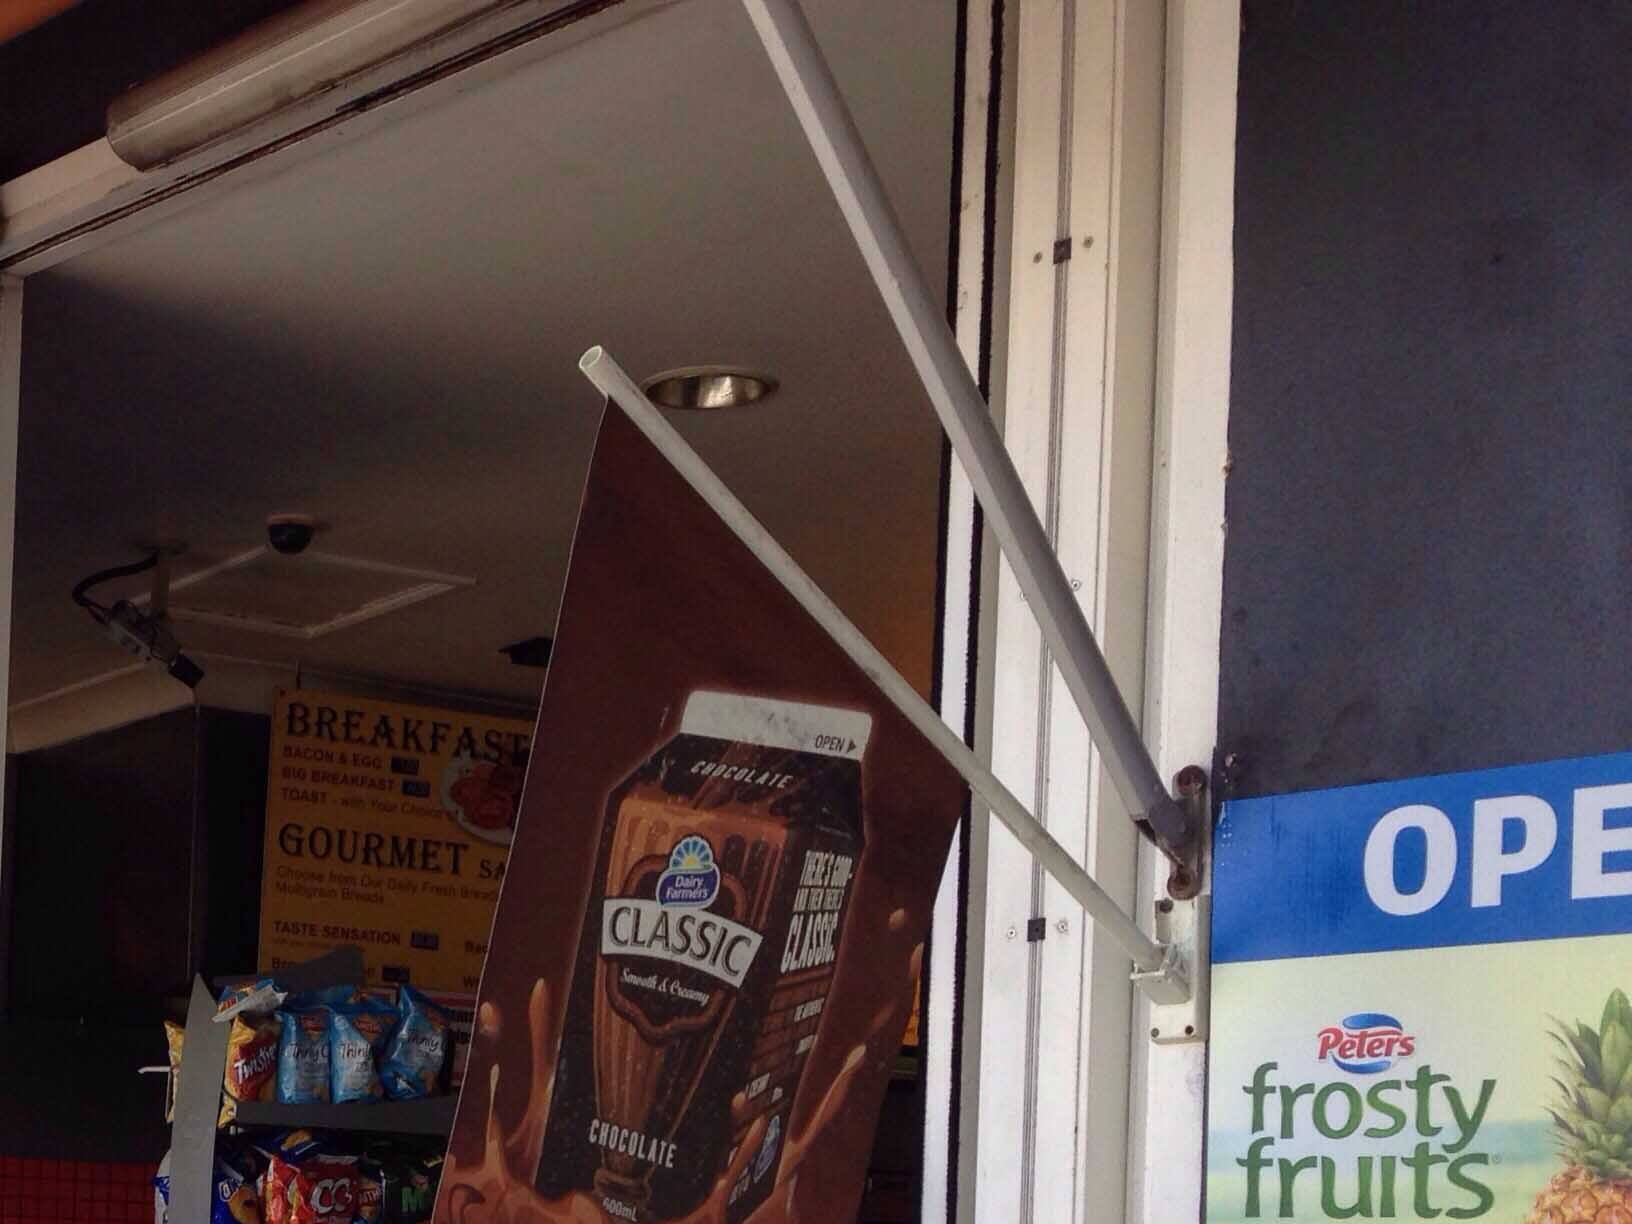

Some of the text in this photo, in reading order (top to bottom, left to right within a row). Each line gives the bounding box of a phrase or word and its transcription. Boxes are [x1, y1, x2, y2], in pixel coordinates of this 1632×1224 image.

[287, 703, 532, 766] BREAKFAST
[814, 734, 846, 753] OPEN
[282, 744, 334, 763] BACON
[352, 754, 384, 769] EGG
[281, 766, 307, 781] BIG
[311, 770, 396, 792] BREAKFAST
[690, 760, 796, 790] CHOCOLATE
[280, 787, 328, 804] TOAST
[278, 823, 469, 876] GOURMET
[1362, 782, 1632, 917] OPE
[664, 885, 710, 900] Farmers
[674, 875, 705, 891] Dairy
[273, 920, 320, 937] TASTE
[320, 926, 402, 945] SENSATION
[609, 905, 753, 977] CLASSIC
[1316, 1025, 1416, 1061] Peters
[1242, 1062, 1497, 1154] frosty
[588, 1118, 678, 1169] CHOCOLATE
[1235, 1136, 1495, 1220] fruits
